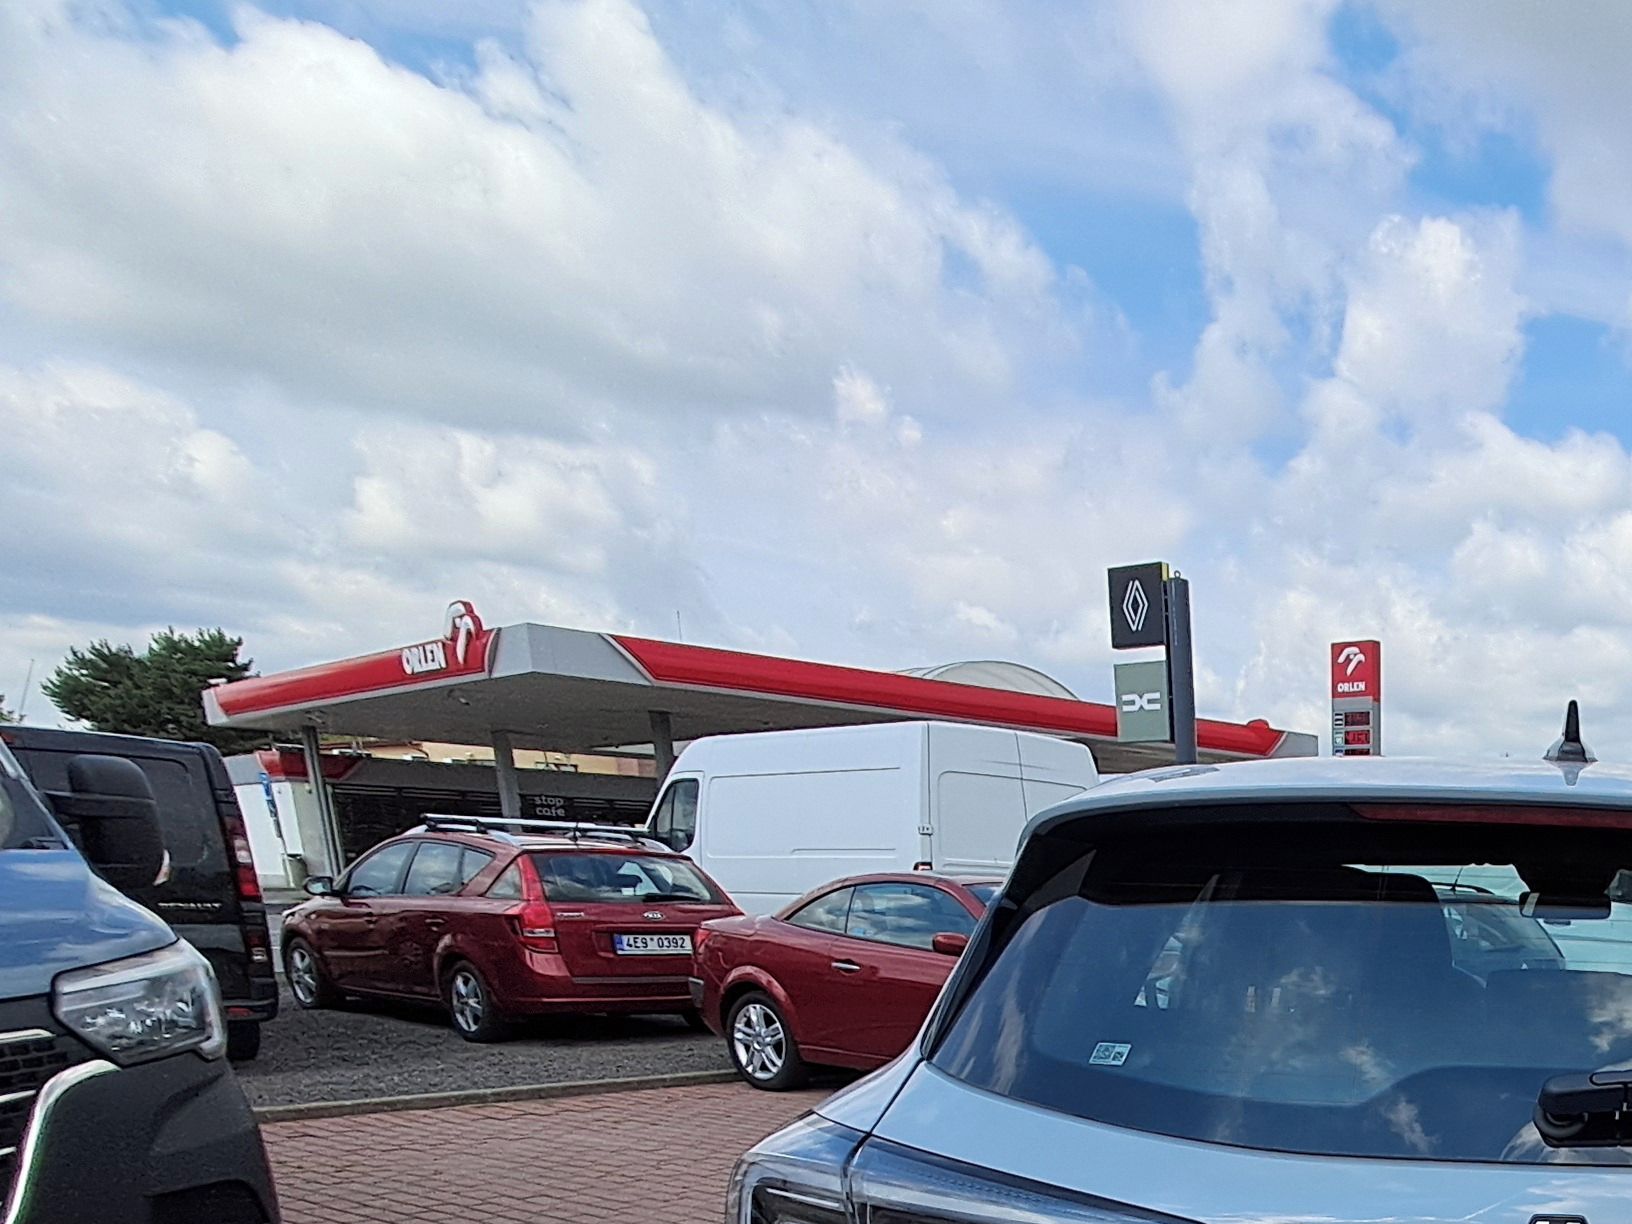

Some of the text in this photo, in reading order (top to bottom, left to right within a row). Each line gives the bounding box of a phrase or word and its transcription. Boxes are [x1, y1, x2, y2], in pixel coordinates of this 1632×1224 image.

[402, 642, 447, 675] ORLEN
[1337, 682, 1366, 692] ORLEN
[533, 796, 564, 806] stop
[535, 807, 565, 816] cafe
[626, 937, 685, 949] 4E9 0392
